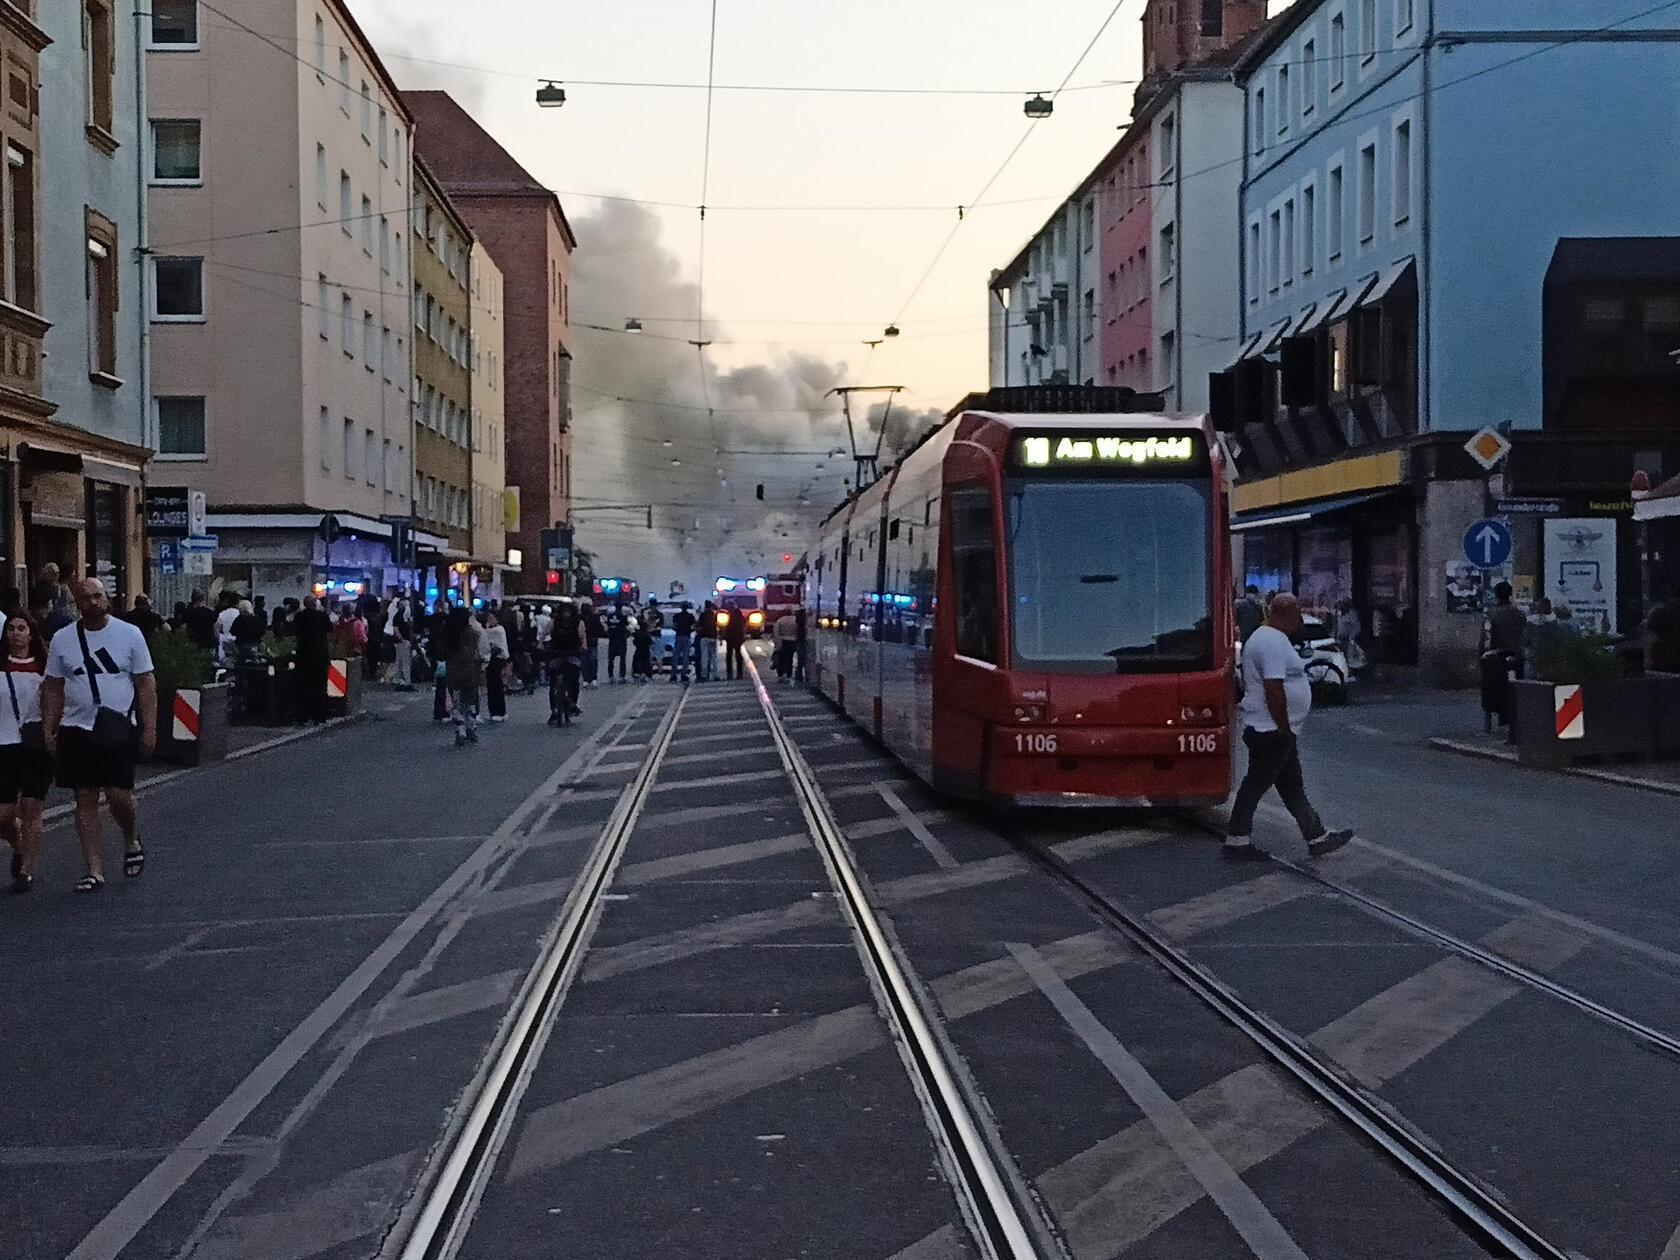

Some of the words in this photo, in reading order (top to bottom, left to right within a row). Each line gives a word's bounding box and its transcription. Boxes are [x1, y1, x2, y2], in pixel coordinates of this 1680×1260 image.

[1056, 437, 1093, 458] Am
[1014, 733, 1057, 753] 1106
[1177, 733, 1217, 753] 1106
